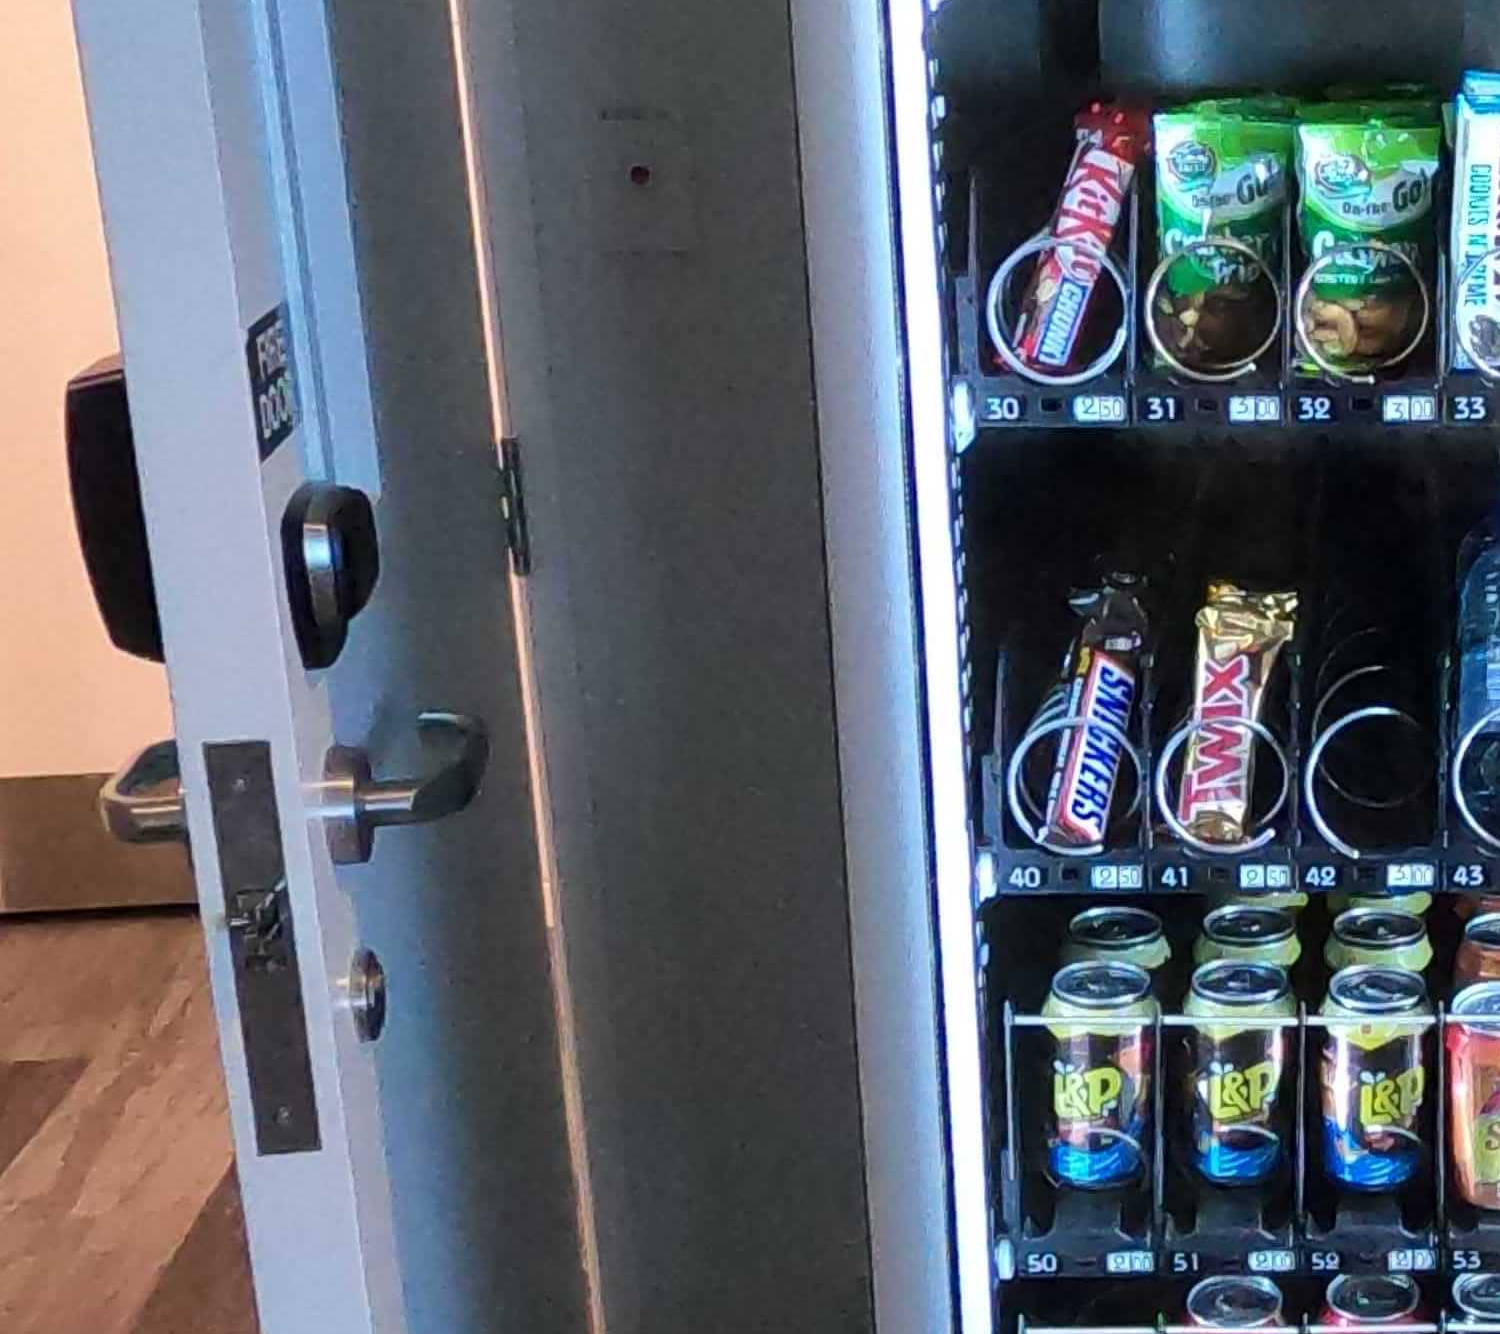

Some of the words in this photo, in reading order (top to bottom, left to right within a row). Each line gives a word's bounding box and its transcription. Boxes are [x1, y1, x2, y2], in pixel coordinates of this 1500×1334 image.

[986, 397, 1019, 420] 30
[1147, 397, 1176, 420] 31
[1299, 397, 1331, 420] 32
[1453, 396, 1486, 420] 33
[1069, 664, 1134, 824] SNICKERS
[1178, 653, 1250, 824] TWIX
[1008, 866, 1041, 888] 40
[1160, 866, 1189, 887] 41
[1304, 865, 1337, 887] 42
[1452, 865, 1484, 887] 43
[1209, 1061, 1277, 1121] L&P
[1026, 1253, 1058, 1272] 50
[1173, 1253, 1200, 1272] 51
[1310, 1252, 1341, 1272] 52
[1452, 1250, 1481, 1268] 53
